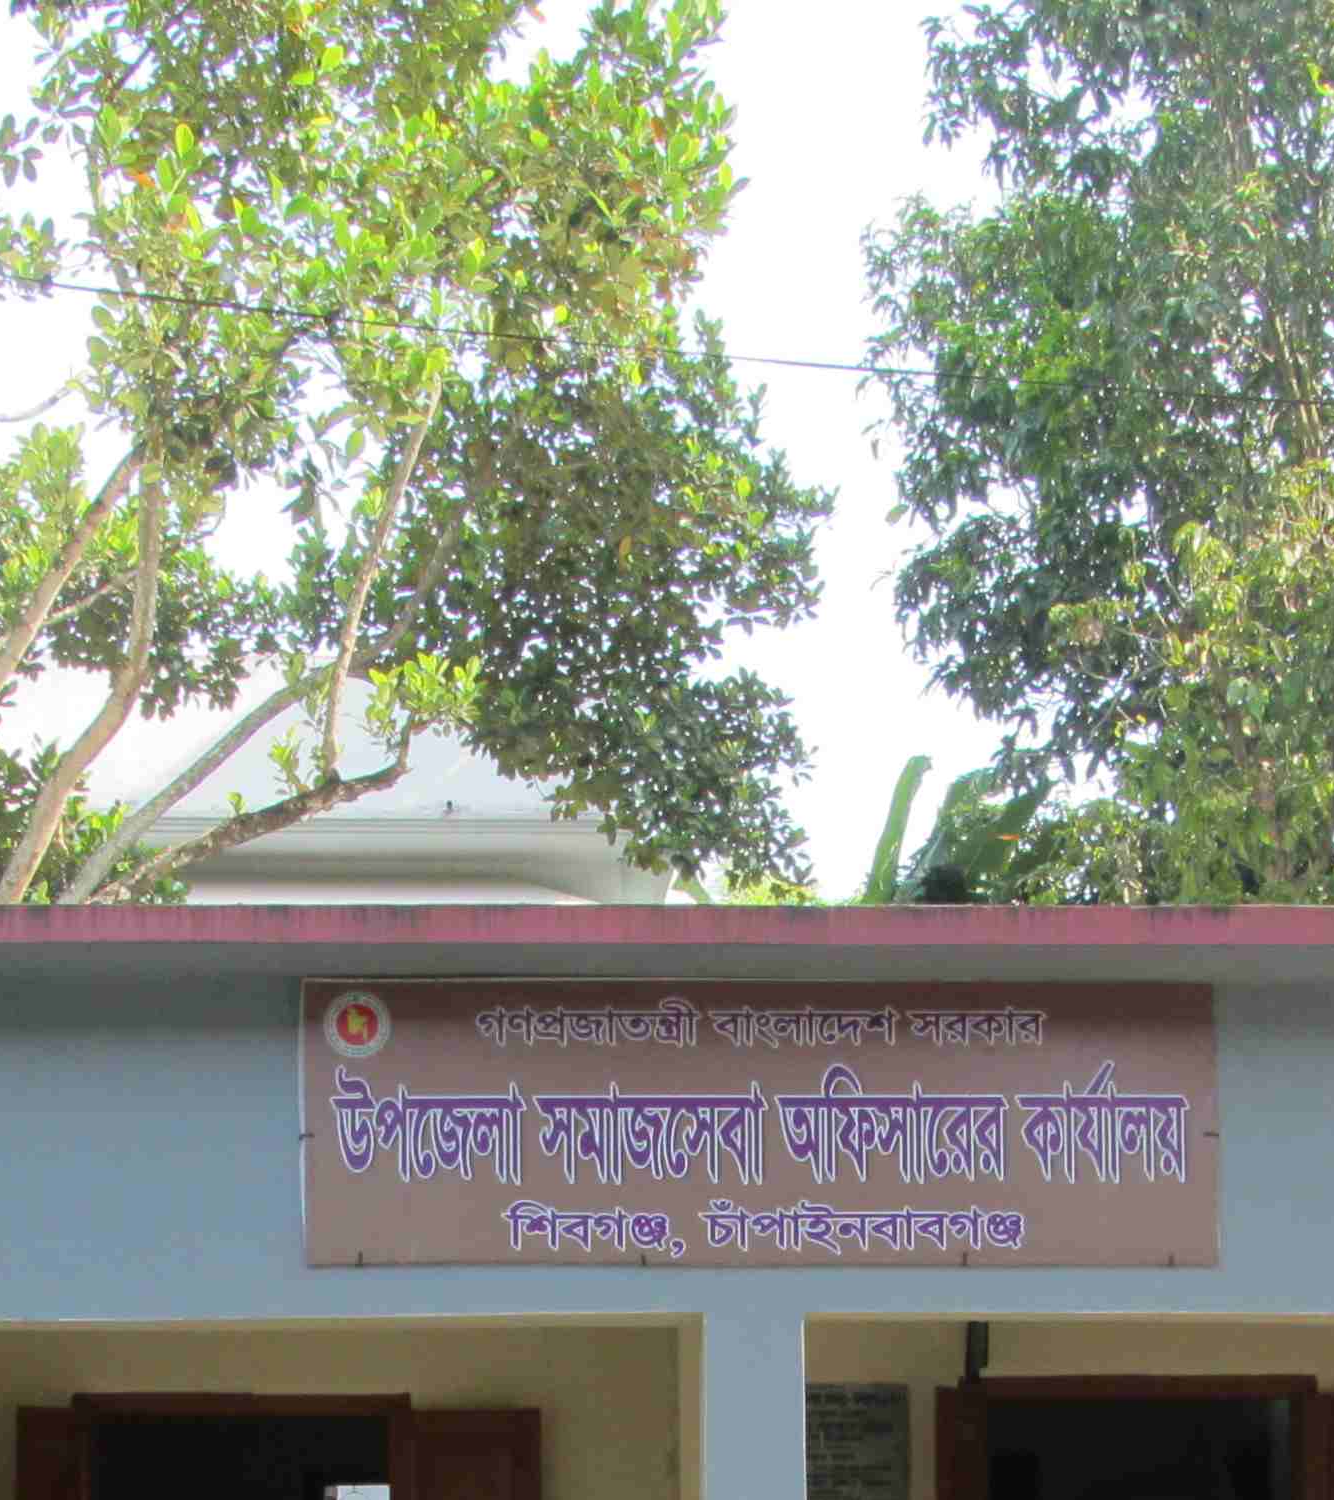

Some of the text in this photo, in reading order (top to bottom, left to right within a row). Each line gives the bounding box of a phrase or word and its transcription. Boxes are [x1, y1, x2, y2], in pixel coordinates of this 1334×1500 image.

[474, 996, 1050, 1049] গণপ্রজাতন্ত্রী বাংলাদেশ সরকার
[329, 1058, 1191, 1187] উপজেলা সমাজসেবা অফিসারের কার্যালয়
[500, 1197, 1028, 1259] শিবগঞ্জ, চাঁপাইনবাবগঞ্জ
